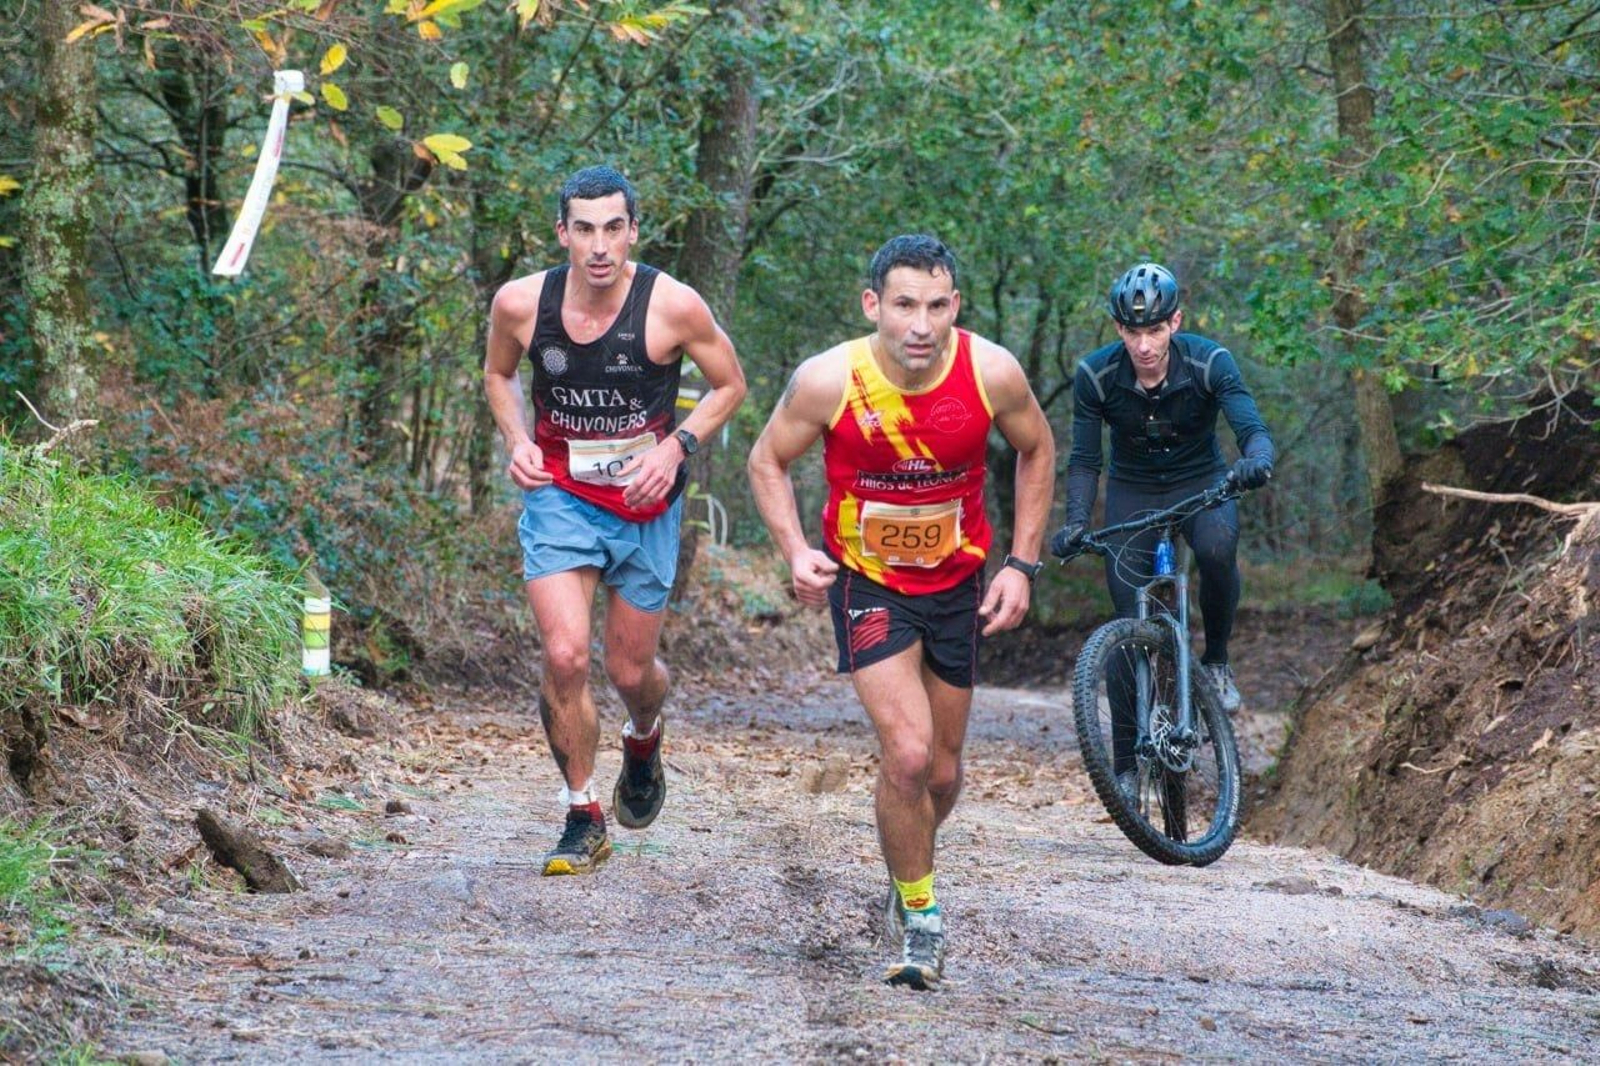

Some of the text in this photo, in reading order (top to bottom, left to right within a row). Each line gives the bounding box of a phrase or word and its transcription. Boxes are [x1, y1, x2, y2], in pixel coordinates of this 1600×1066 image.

[551, 386, 644, 411] GMTA &
[550, 409, 648, 433] CHUVONERS
[880, 524, 942, 550] 259
